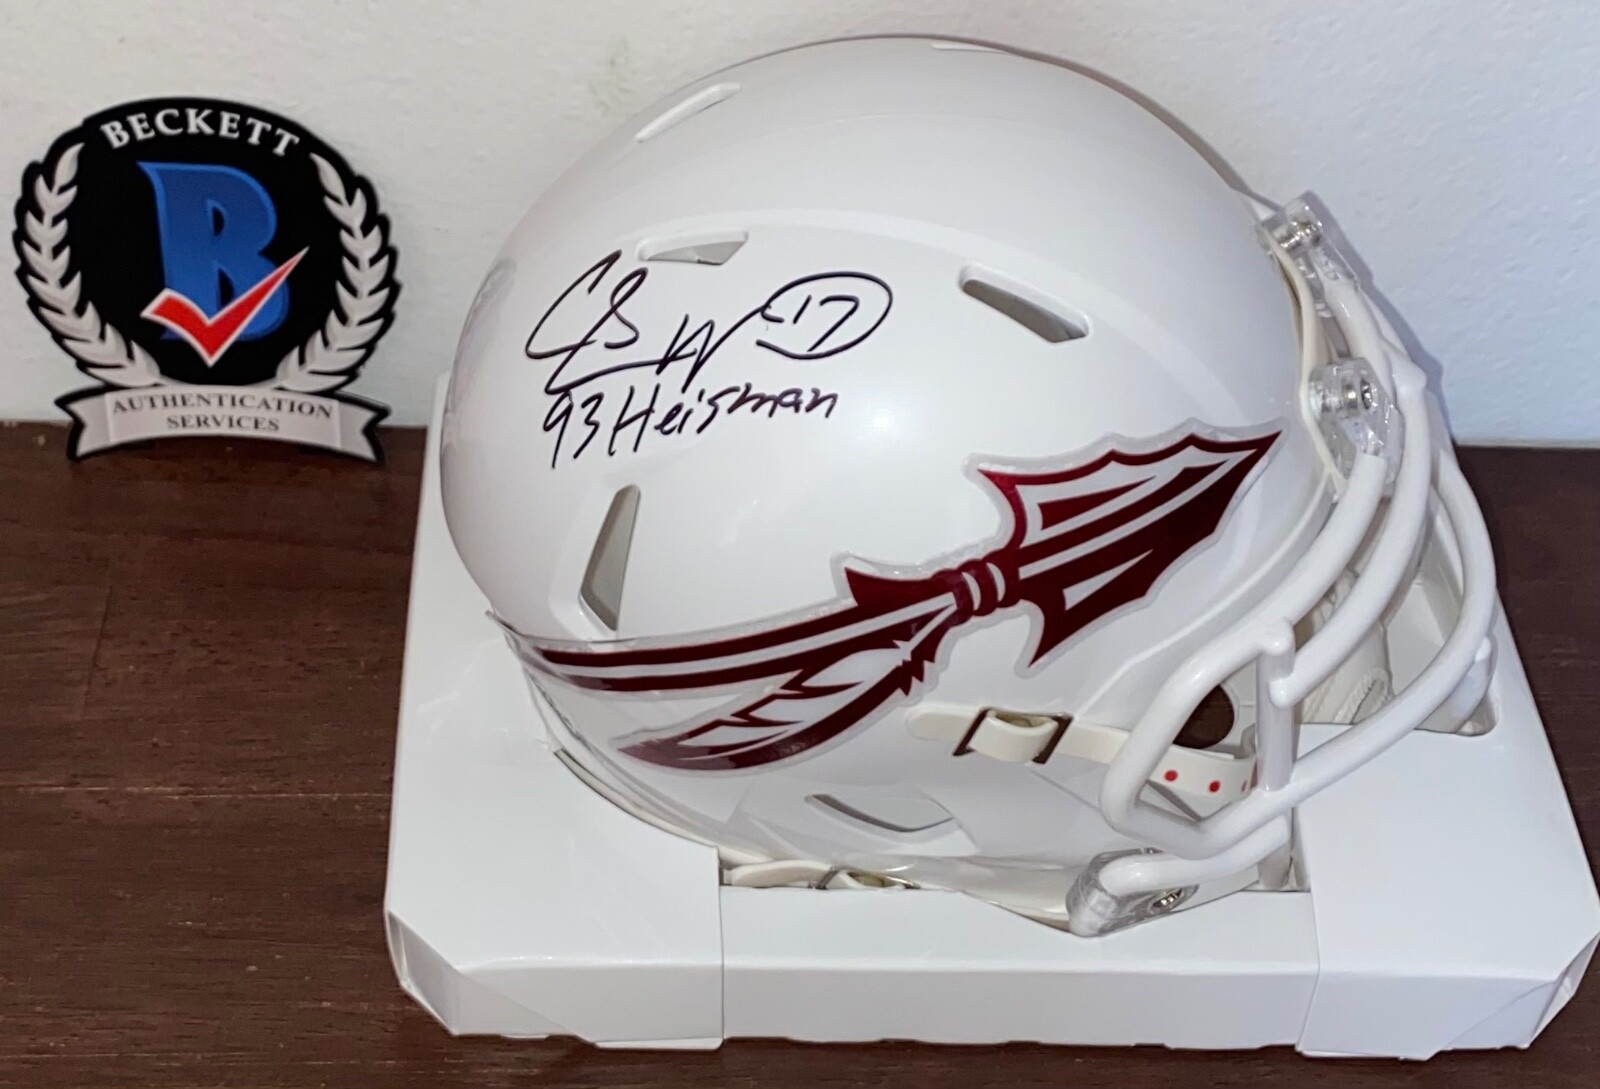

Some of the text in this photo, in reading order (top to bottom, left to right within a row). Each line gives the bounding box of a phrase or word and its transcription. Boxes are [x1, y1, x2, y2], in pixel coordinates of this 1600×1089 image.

[101, 107, 300, 157] BECKETT
[112, 392, 333, 419] AUTHENTICATION
[167, 413, 280, 433] SERVICES
[608, 382, 838, 456] Heisman
